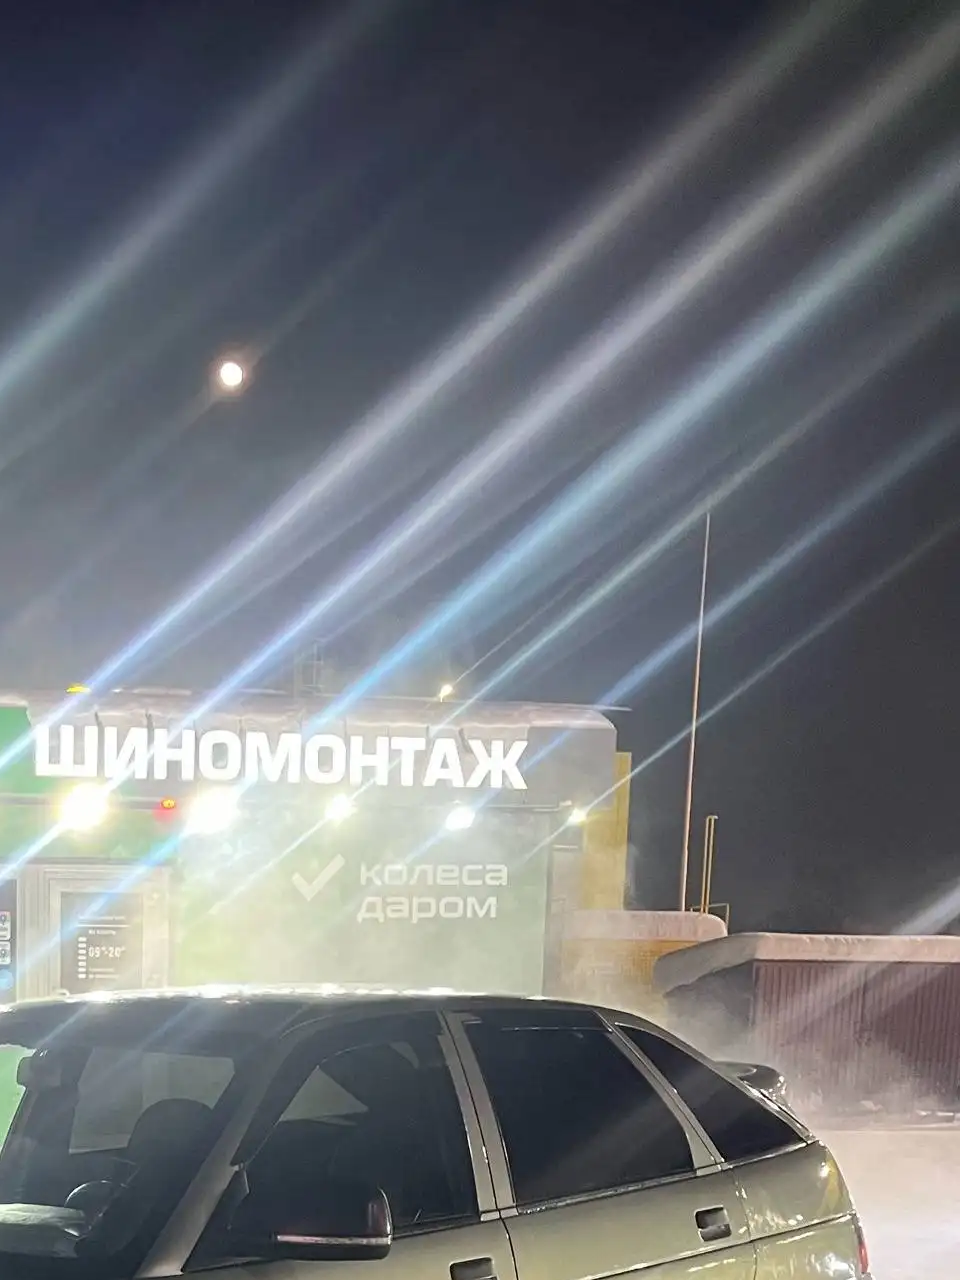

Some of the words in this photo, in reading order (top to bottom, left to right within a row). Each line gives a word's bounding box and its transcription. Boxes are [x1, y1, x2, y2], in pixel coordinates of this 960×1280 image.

[35, 724, 529, 790] ШИНОМОНТАЖ
[359, 863, 509, 886] колеса
[356, 896, 498, 924] даром
